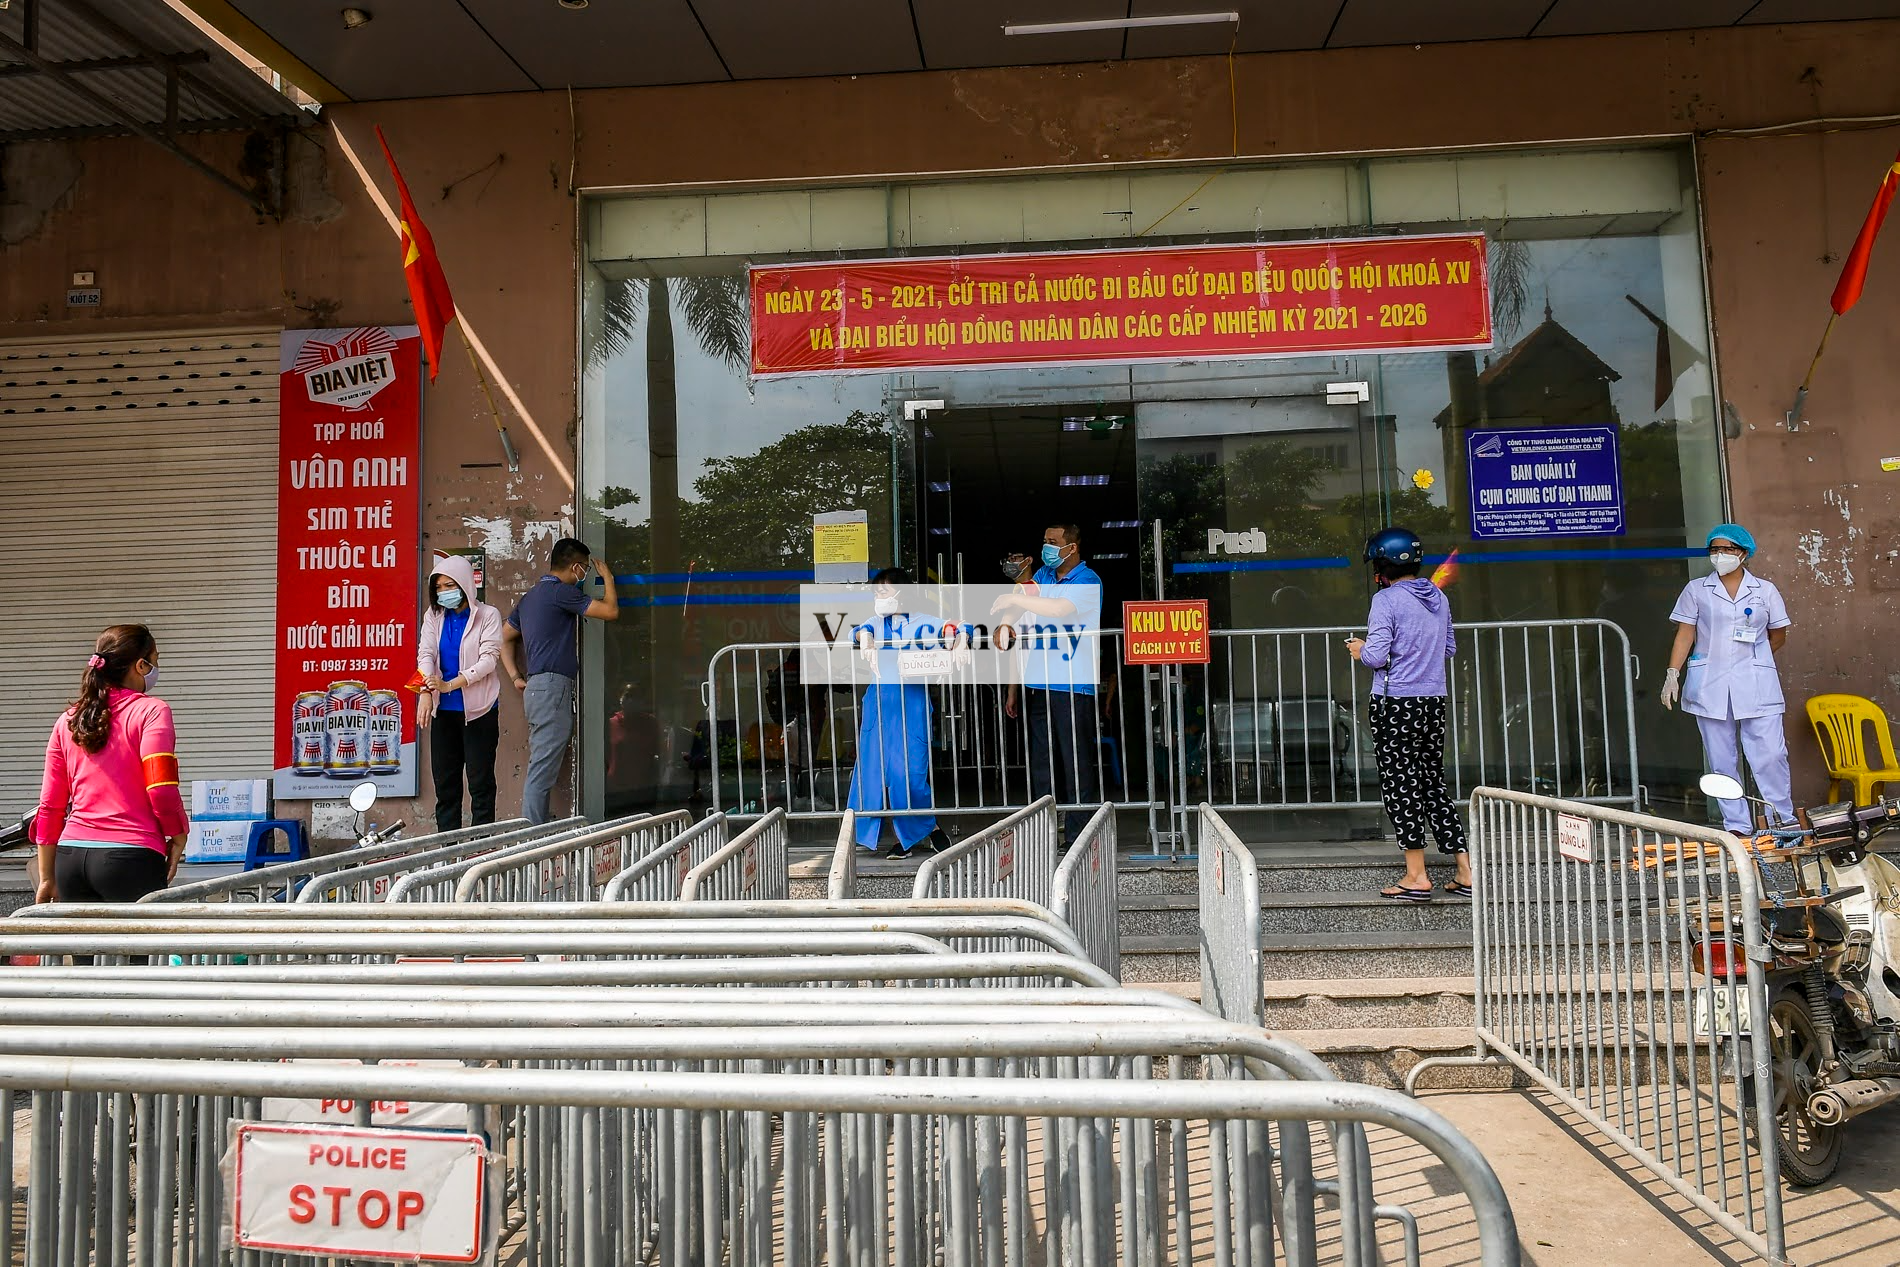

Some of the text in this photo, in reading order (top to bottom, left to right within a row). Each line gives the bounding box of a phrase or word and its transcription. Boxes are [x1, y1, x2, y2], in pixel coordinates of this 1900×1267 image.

[765, 289, 815, 314] NGÀY
[821, 291, 843, 311] 23
[861, 288, 873, 310] 5
[892, 285, 942, 310] 2021,
[948, 276, 975, 306] CỬ
[979, 282, 1008, 305] TRI
[1014, 273, 1039, 303] CẢ
[1045, 274, 1097, 302] NƯỚC
[1103, 277, 1121, 299] ĐI
[1130, 267, 1166, 299] BẦU
[1172, 265, 1199, 297] CỬ
[1204, 271, 1235, 300] ĐẠI
[1242, 261, 1285, 293] BIỂU
[1291, 259, 1343, 291] QUỐC
[1349, 261, 1381, 294] HỘI
[1388, 258, 1441, 287] KHOÁ
[1446, 261, 1471, 285] XV
[88, 294, 98, 303] 52
[809, 323, 833, 350] VÀ
[838, 326, 870, 353] ĐẠI
[876, 315, 918, 348] BIỂU
[925, 322, 955, 350] HỘI
[962, 313, 1013, 345] ĐỒNG
[1020, 313, 1073, 342] NHÂN
[1079, 312, 1118, 340] DÂN
[1124, 310, 1163, 338] CÁC
[1169, 305, 1207, 337] CẤP
[1213, 308, 1277, 339] NHIỆM
[1283, 303, 1305, 332] KỲ
[1313, 306, 1358, 330] 2021
[1380, 303, 1427, 328] 2026
[310, 357, 388, 396] BIA VIỆT
[314, 418, 384, 444] TẠP HOÁ
[1545, 436, 1561, 445] QUẢN
[290, 453, 408, 489] VÂN ANH
[1511, 457, 1576, 481] BAN QUẢN LÝ
[1480, 485, 1612, 508] CỤM CHUNG CƯ ĐẠI THANH
[307, 499, 393, 531] SIM THẺ
[1208, 528, 1267, 555] Push
[297, 539, 397, 571] THUỐC LÁ
[327, 579, 371, 609] BỈM
[286, 618, 405, 650] NƯỚC GIẢI KHÁT
[1131, 608, 1203, 636] KHU VỰC
[1133, 636, 1202, 655] CÁCH LY Y TẾ
[302, 659, 389, 673] ĐT: 0987 339 372
[903, 660, 949, 670] DỪNG LẠI
[296, 720, 310, 734] BIA
[328, 717, 345, 730] BIA
[345, 713, 367, 731] VIỆT
[379, 718, 397, 733] VIỆT
[208, 795, 230, 804] true
[210, 788, 221, 796] TH
[202, 836, 223, 846] true
[321, 1097, 410, 1114] POICE
[309, 1143, 407, 1171] POLICE
[289, 1184, 425, 1231] STOP
